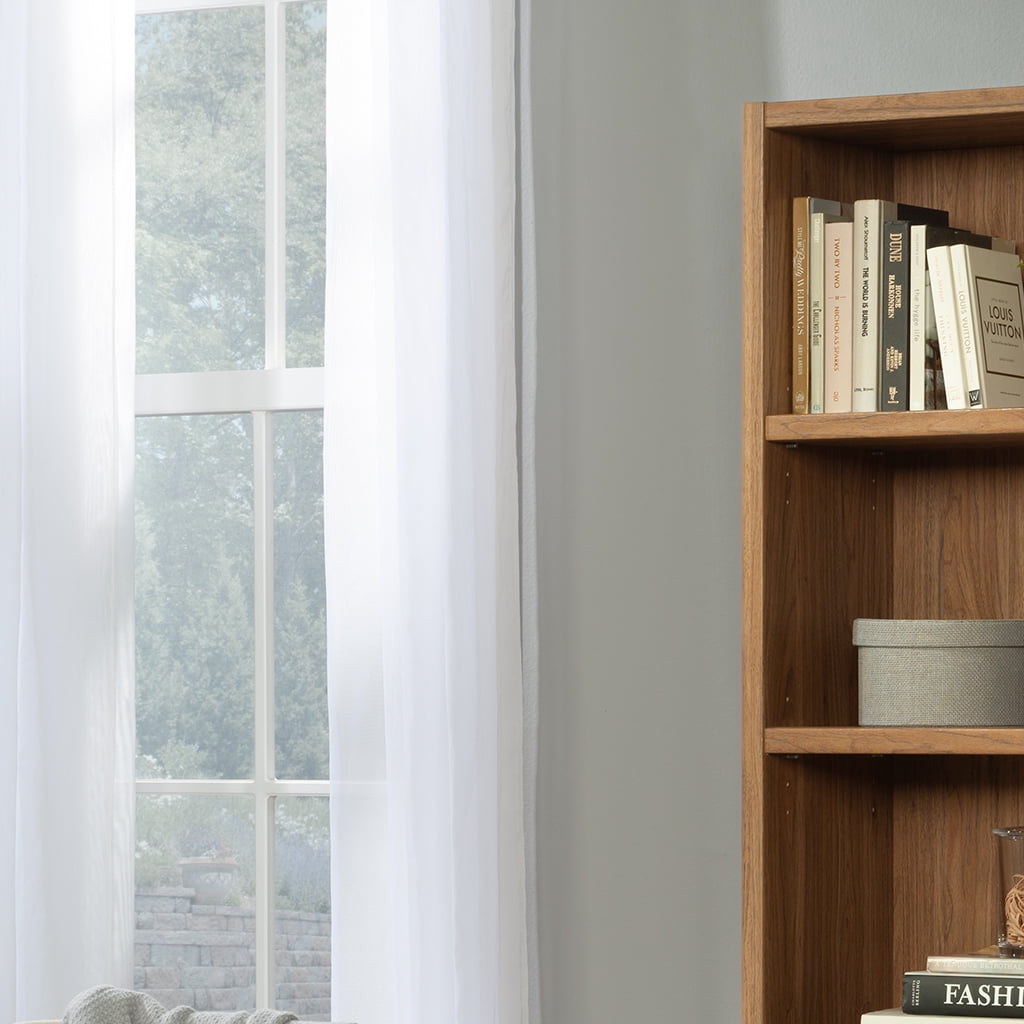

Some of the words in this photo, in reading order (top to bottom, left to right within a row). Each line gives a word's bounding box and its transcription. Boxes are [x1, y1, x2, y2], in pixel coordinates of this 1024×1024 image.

[833, 238, 841, 258] TWO
[889, 232, 903, 263] DUNE
[833, 259, 841, 268] BY
[861, 267, 870, 278] THE
[833, 269, 841, 289] TWO
[861, 280, 870, 300] WORLD
[887, 274, 896, 319] HARKONNEN
[894, 284, 902, 309] HOUSE
[913, 288, 921, 301] the
[958, 290, 969, 315] LOUIS
[796, 279, 805, 336] WEDDINGS
[911, 304, 921, 327] hygge
[989, 305, 1014, 322] LOUIS
[832, 306, 841, 345] NICHOLAS
[860, 310, 870, 337] BURNING
[913, 328, 921, 342] life
[961, 316, 972, 354] VUITTON
[984, 320, 1022, 340] VUITTON
[832, 347, 840, 372] SPARKS
